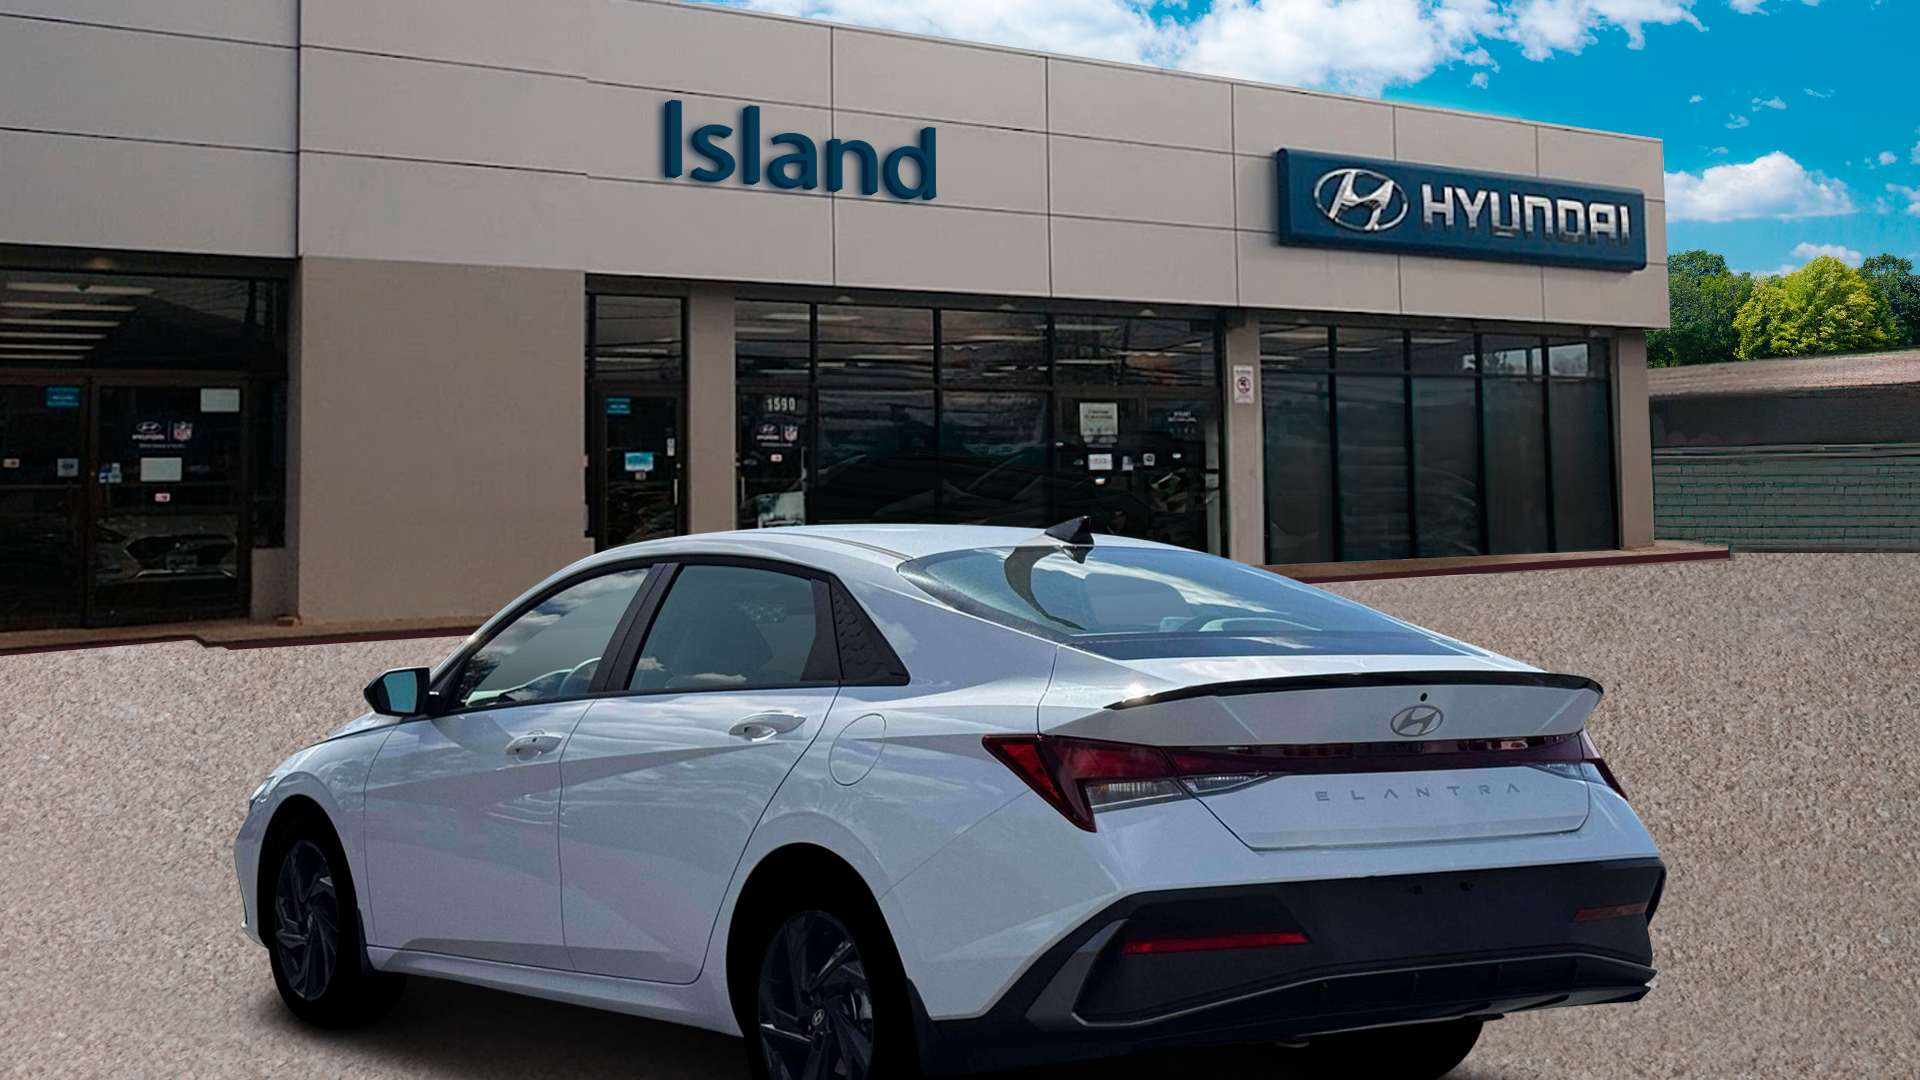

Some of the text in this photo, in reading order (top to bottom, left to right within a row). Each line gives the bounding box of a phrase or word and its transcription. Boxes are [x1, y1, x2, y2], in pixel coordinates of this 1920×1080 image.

[664, 99, 937, 200] Island
[1422, 184, 1630, 243] HYUNDAI
[767, 396, 796, 412] 1590
[1314, 783, 1520, 801] ELANTRA
